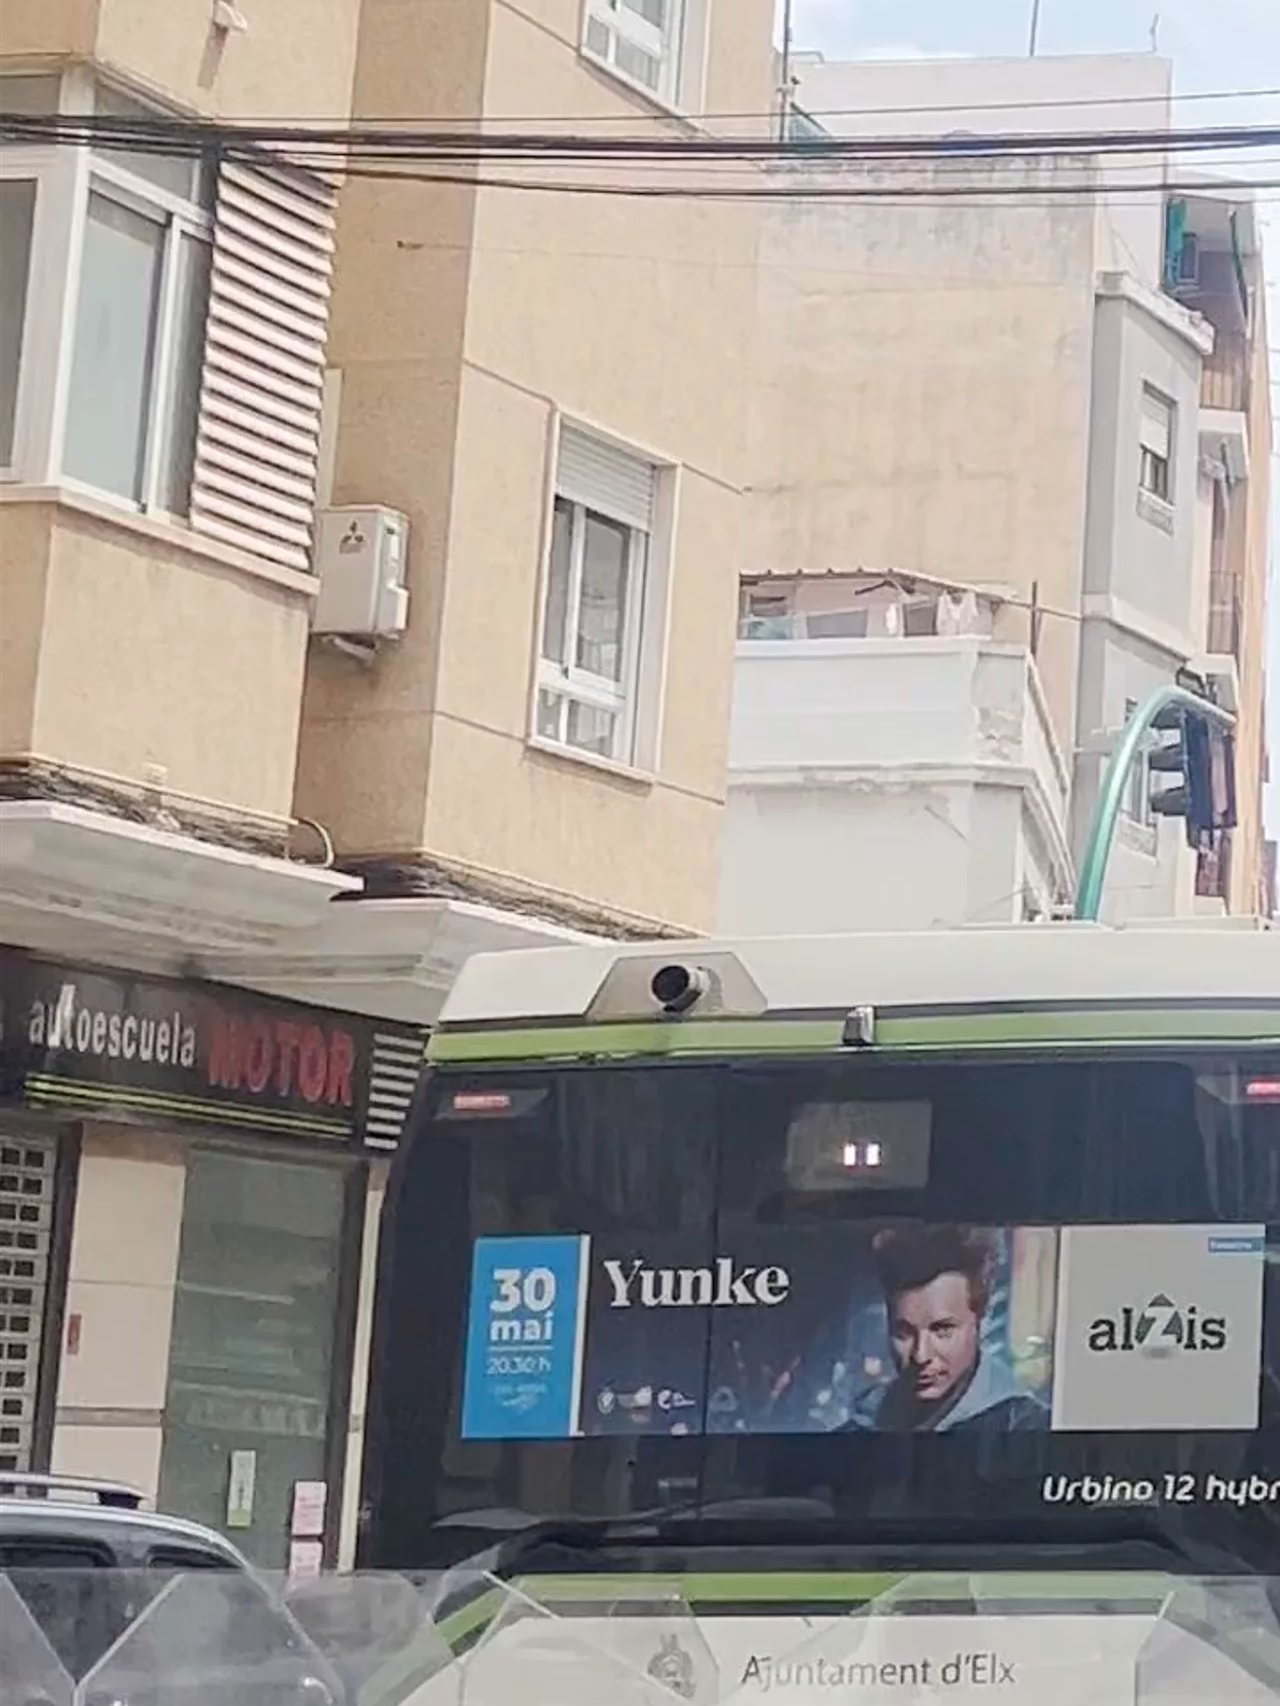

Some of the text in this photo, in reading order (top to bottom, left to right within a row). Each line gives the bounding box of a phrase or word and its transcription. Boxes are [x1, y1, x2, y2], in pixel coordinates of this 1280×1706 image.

[28, 983, 355, 1108] autoescuela MOTOR
[490, 1267, 556, 1313] 30
[603, 1258, 790, 1307] Yunke
[1043, 1476, 1154, 1503] Urbino
[1164, 1476, 1195, 1502] 12
[741, 1654, 931, 1691] Ajuntament
